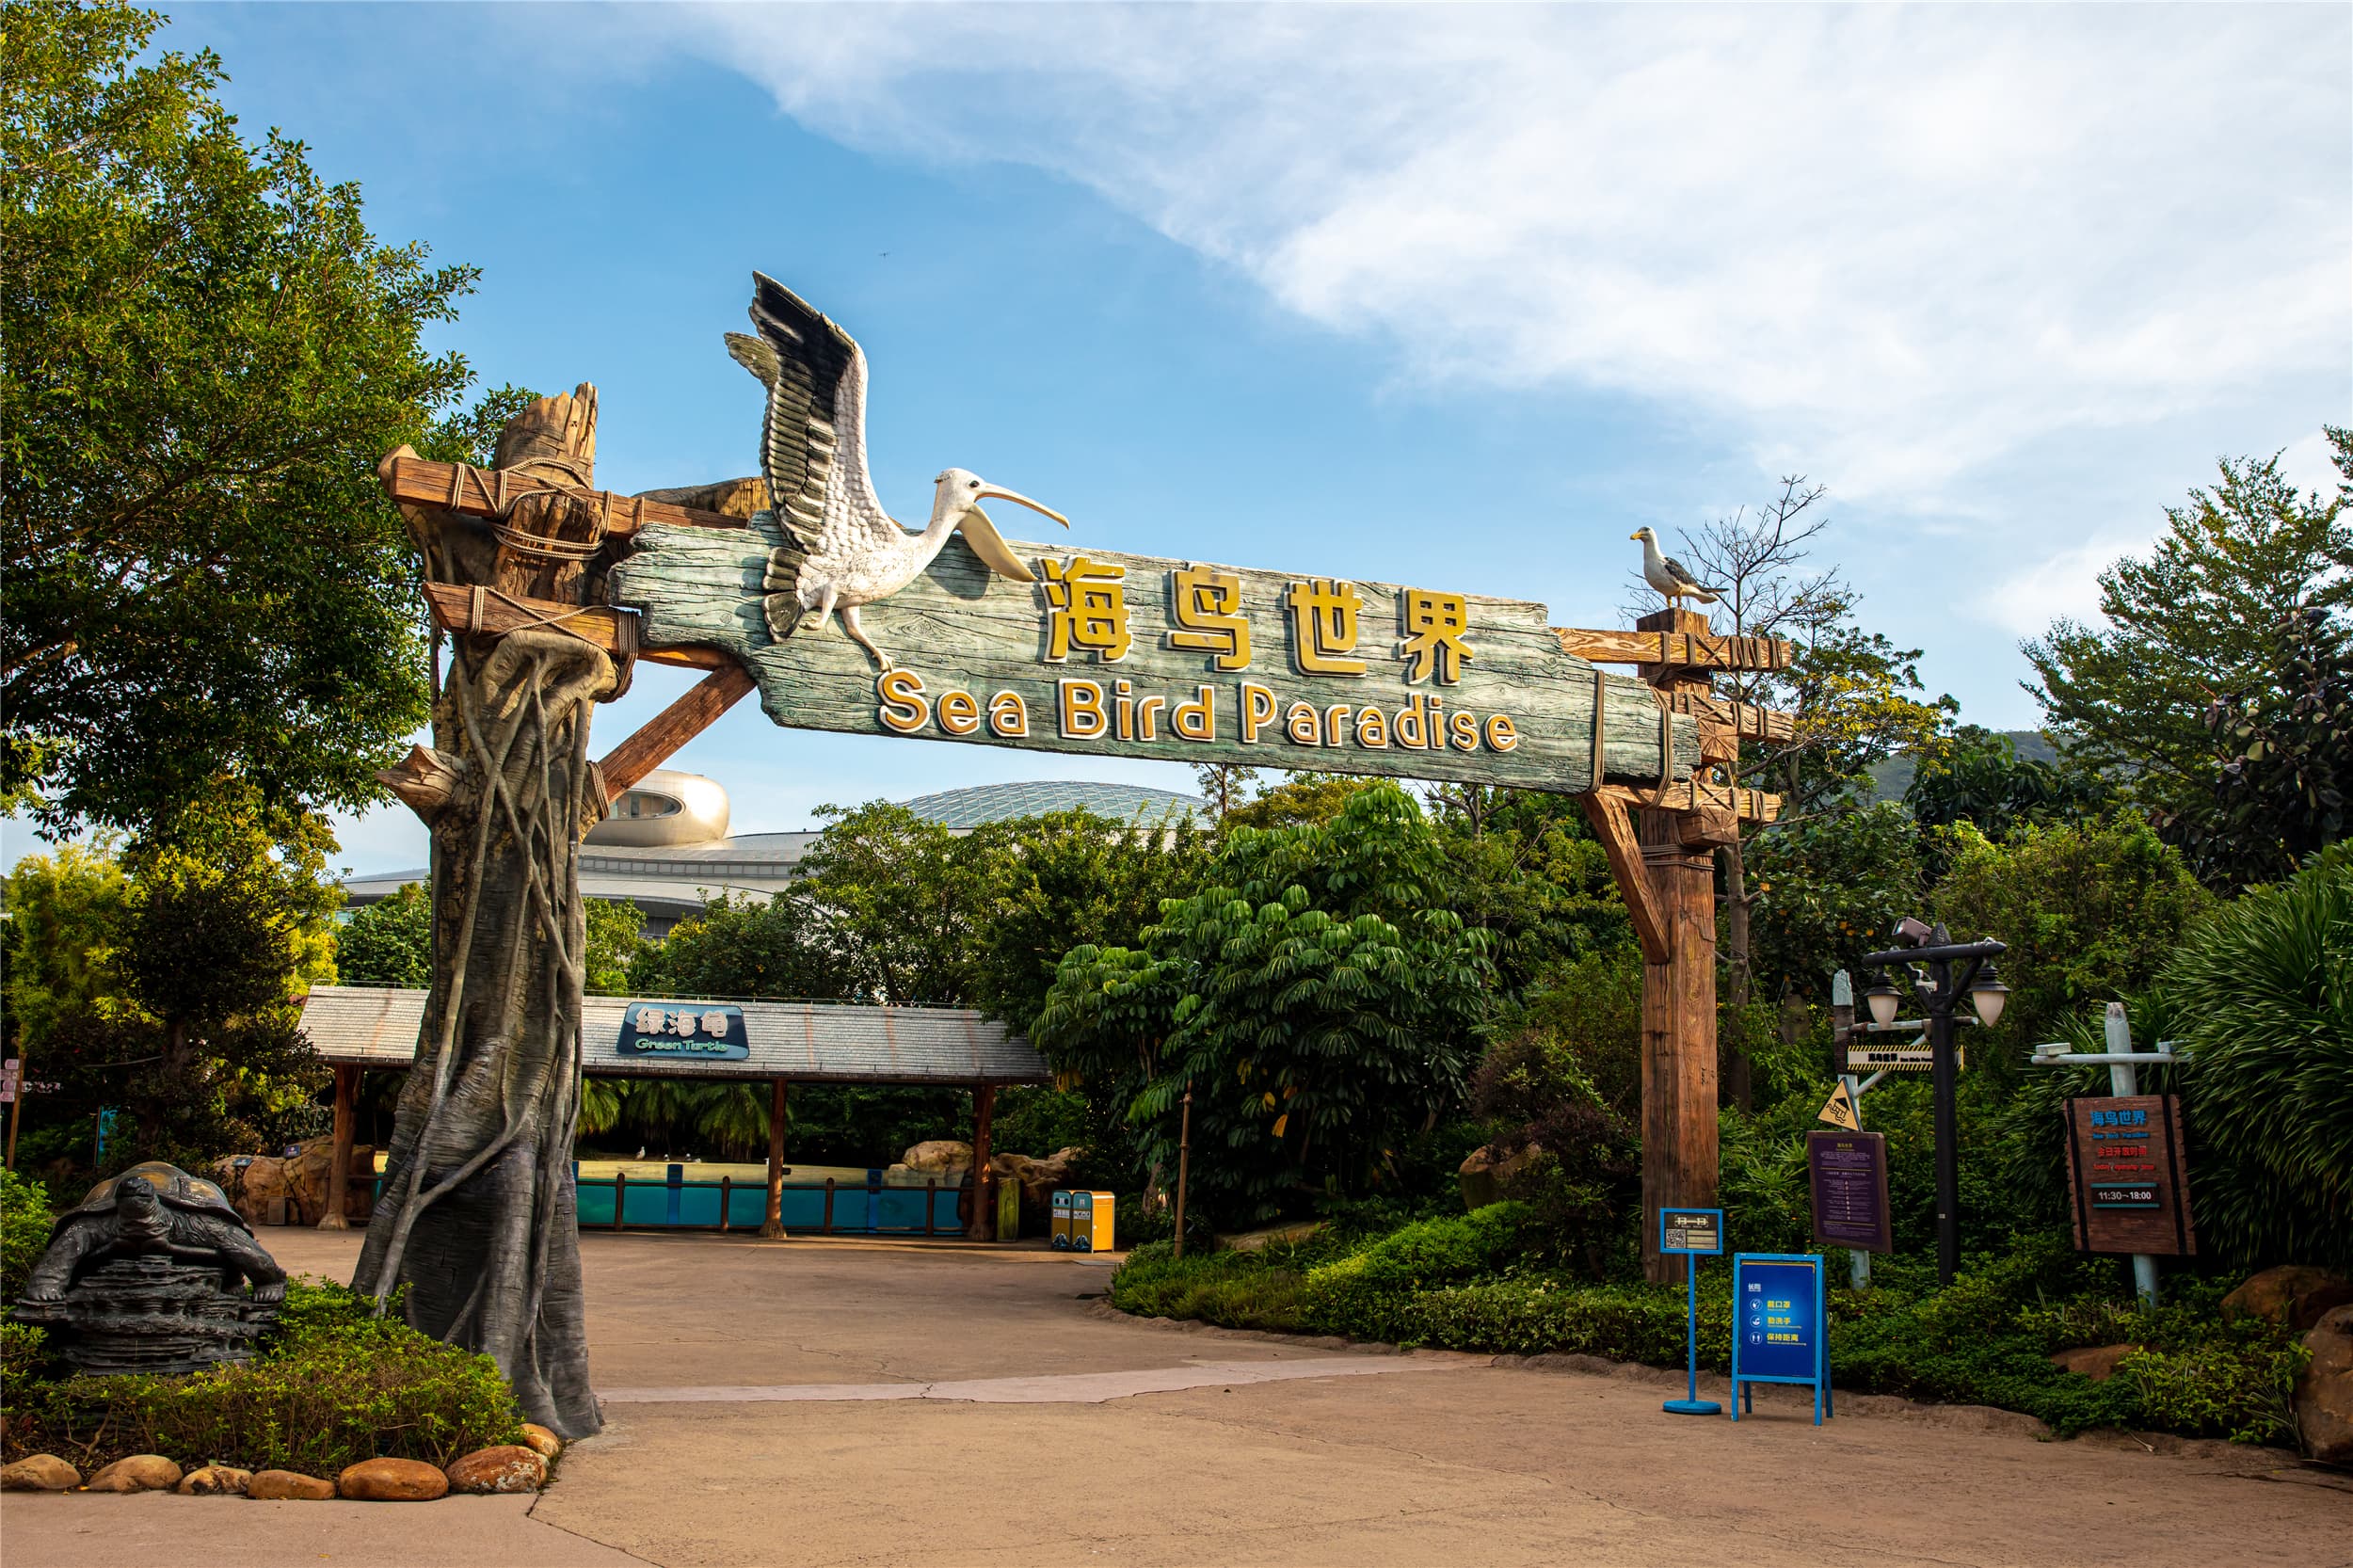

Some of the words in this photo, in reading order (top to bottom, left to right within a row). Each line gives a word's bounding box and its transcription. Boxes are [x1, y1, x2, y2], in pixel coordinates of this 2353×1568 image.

[1036, 554, 1474, 686] 海鸟世界
[877, 667, 1030, 734] Sea
[1058, 678, 1217, 743] Bird
[1241, 681, 1518, 753] Paradise
[635, 1006, 728, 1037] 绿海龟
[635, 1038, 682, 1049] Green
[683, 1039, 729, 1052] Turtle
[2090, 1110, 2147, 1127] 海鸟世界
[1767, 1333, 1799, 1342] 保持距离
